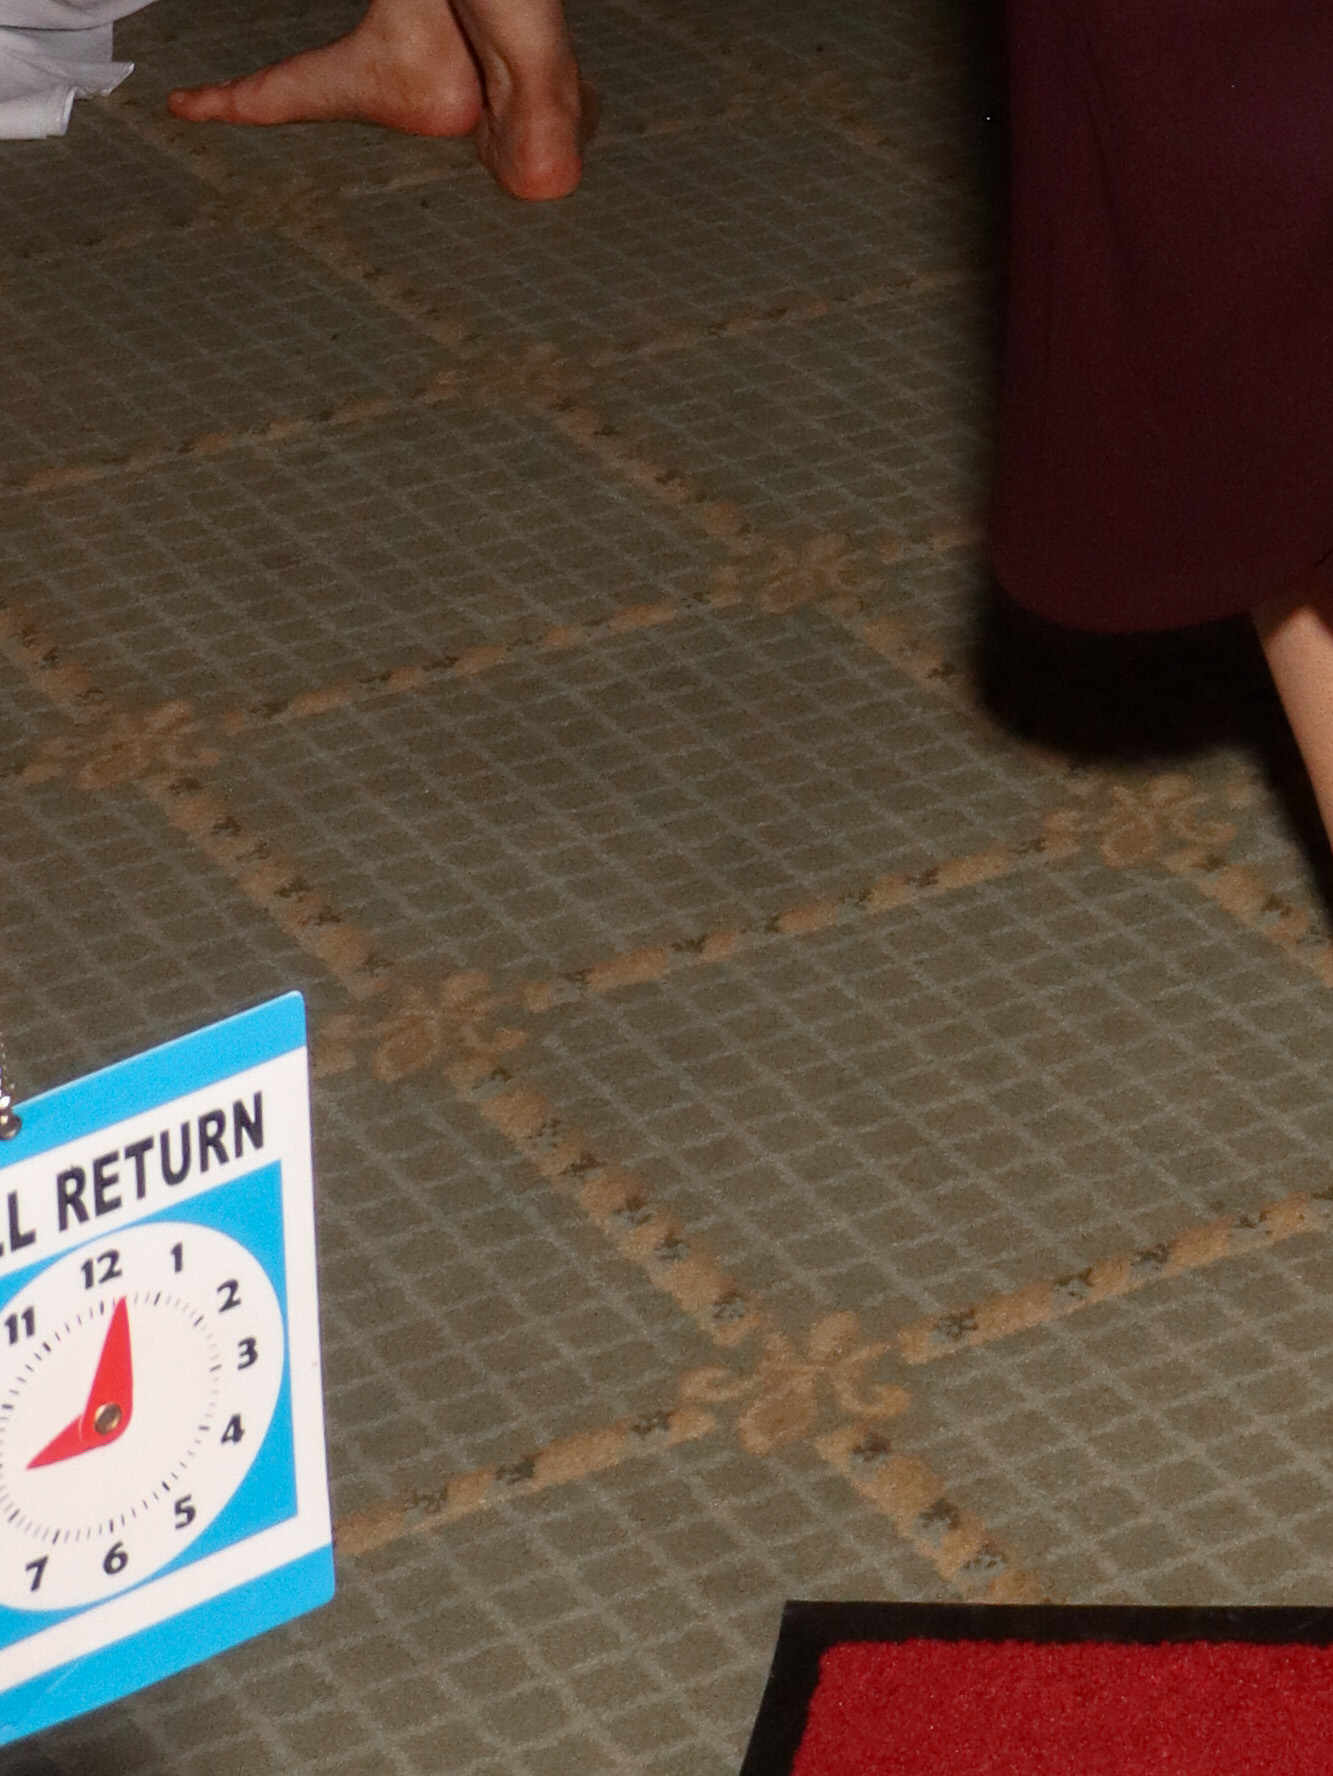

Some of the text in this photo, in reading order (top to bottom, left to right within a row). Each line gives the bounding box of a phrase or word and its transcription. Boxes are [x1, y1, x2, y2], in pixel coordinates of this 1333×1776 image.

[0, 1090, 266, 1257] L RETURN
[81, 1249, 122, 1289] 12
[170, 1242, 185, 1274] 1
[217, 1279, 241, 1312] 2
[4, 1305, 36, 1346] 11
[237, 1337, 259, 1370] 3
[220, 1414, 245, 1445] 4
[174, 1495, 196, 1526] 5
[25, 1555, 49, 1592] 7
[103, 1542, 129, 1576] 6
